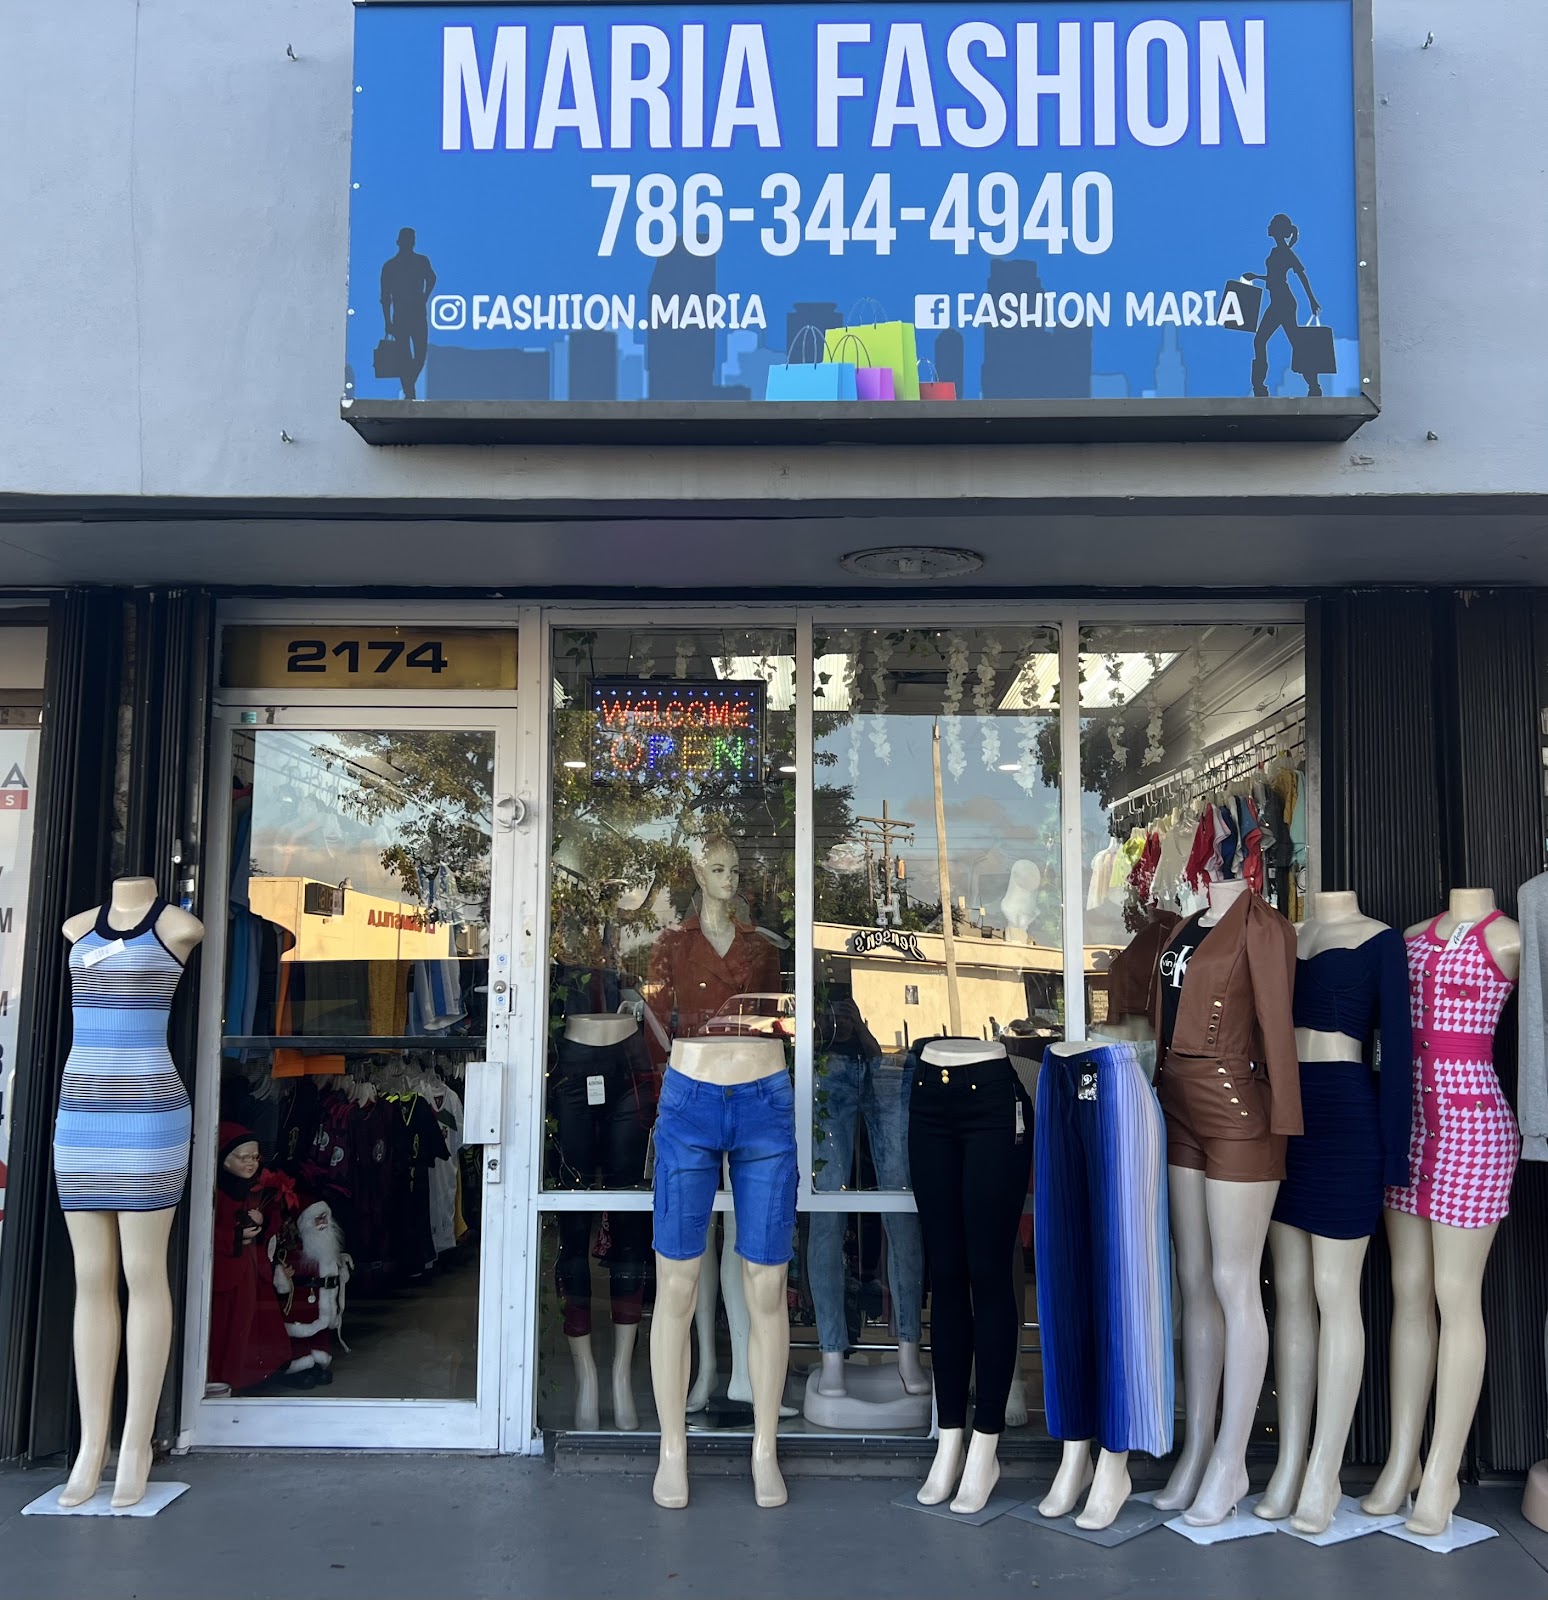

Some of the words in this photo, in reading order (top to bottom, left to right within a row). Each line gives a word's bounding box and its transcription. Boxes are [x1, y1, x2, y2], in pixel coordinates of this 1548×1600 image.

[442, 24, 781, 151] MARIA
[816, 19, 1267, 149] FASHION
[591, 171, 1113, 257] 786-344-4940
[472, 293, 767, 331] FASHIION.MARIA
[957, 291, 1111, 328] FASHION
[1125, 290, 1245, 327] MARIA
[287, 640, 448, 673] 2174
[602, 699, 749, 727] WELCOME
[611, 733, 745, 770] OPEN
